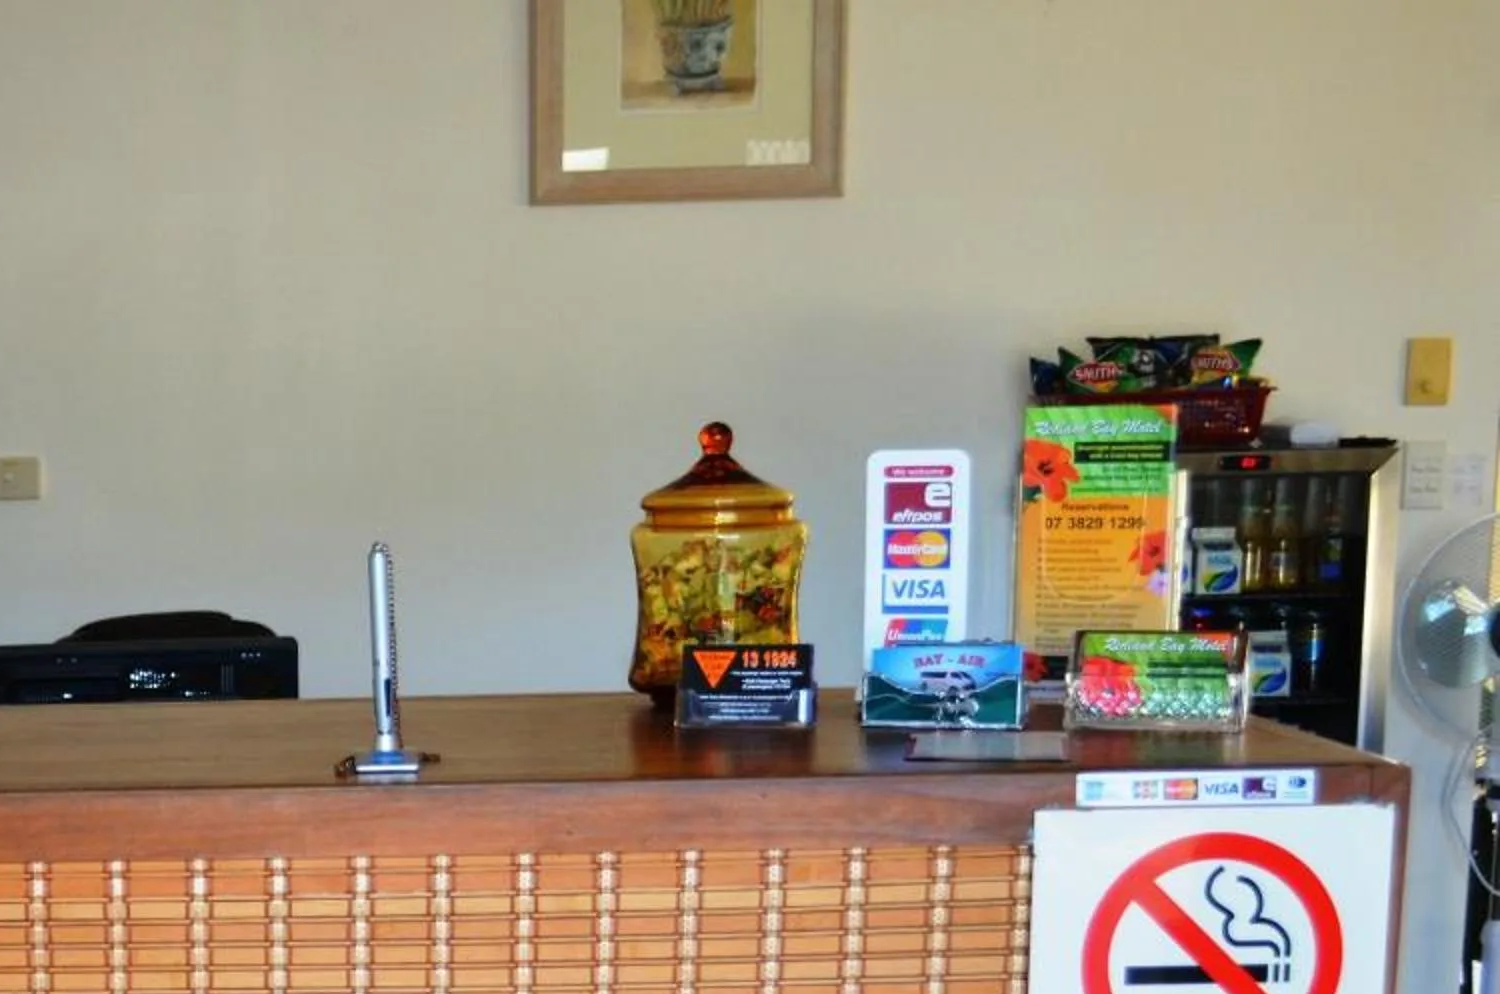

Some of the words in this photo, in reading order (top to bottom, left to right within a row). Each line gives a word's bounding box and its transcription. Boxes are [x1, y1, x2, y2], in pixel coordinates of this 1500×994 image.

[1092, 418, 1117, 437] Bay
[1123, 418, 1162, 433] Motel
[892, 508, 943, 523] eftpos
[1045, 516, 1062, 530] 07
[891, 579, 946, 599] VISA
[1160, 637, 1186, 653] Bay
[1203, 782, 1240, 796] VISA
